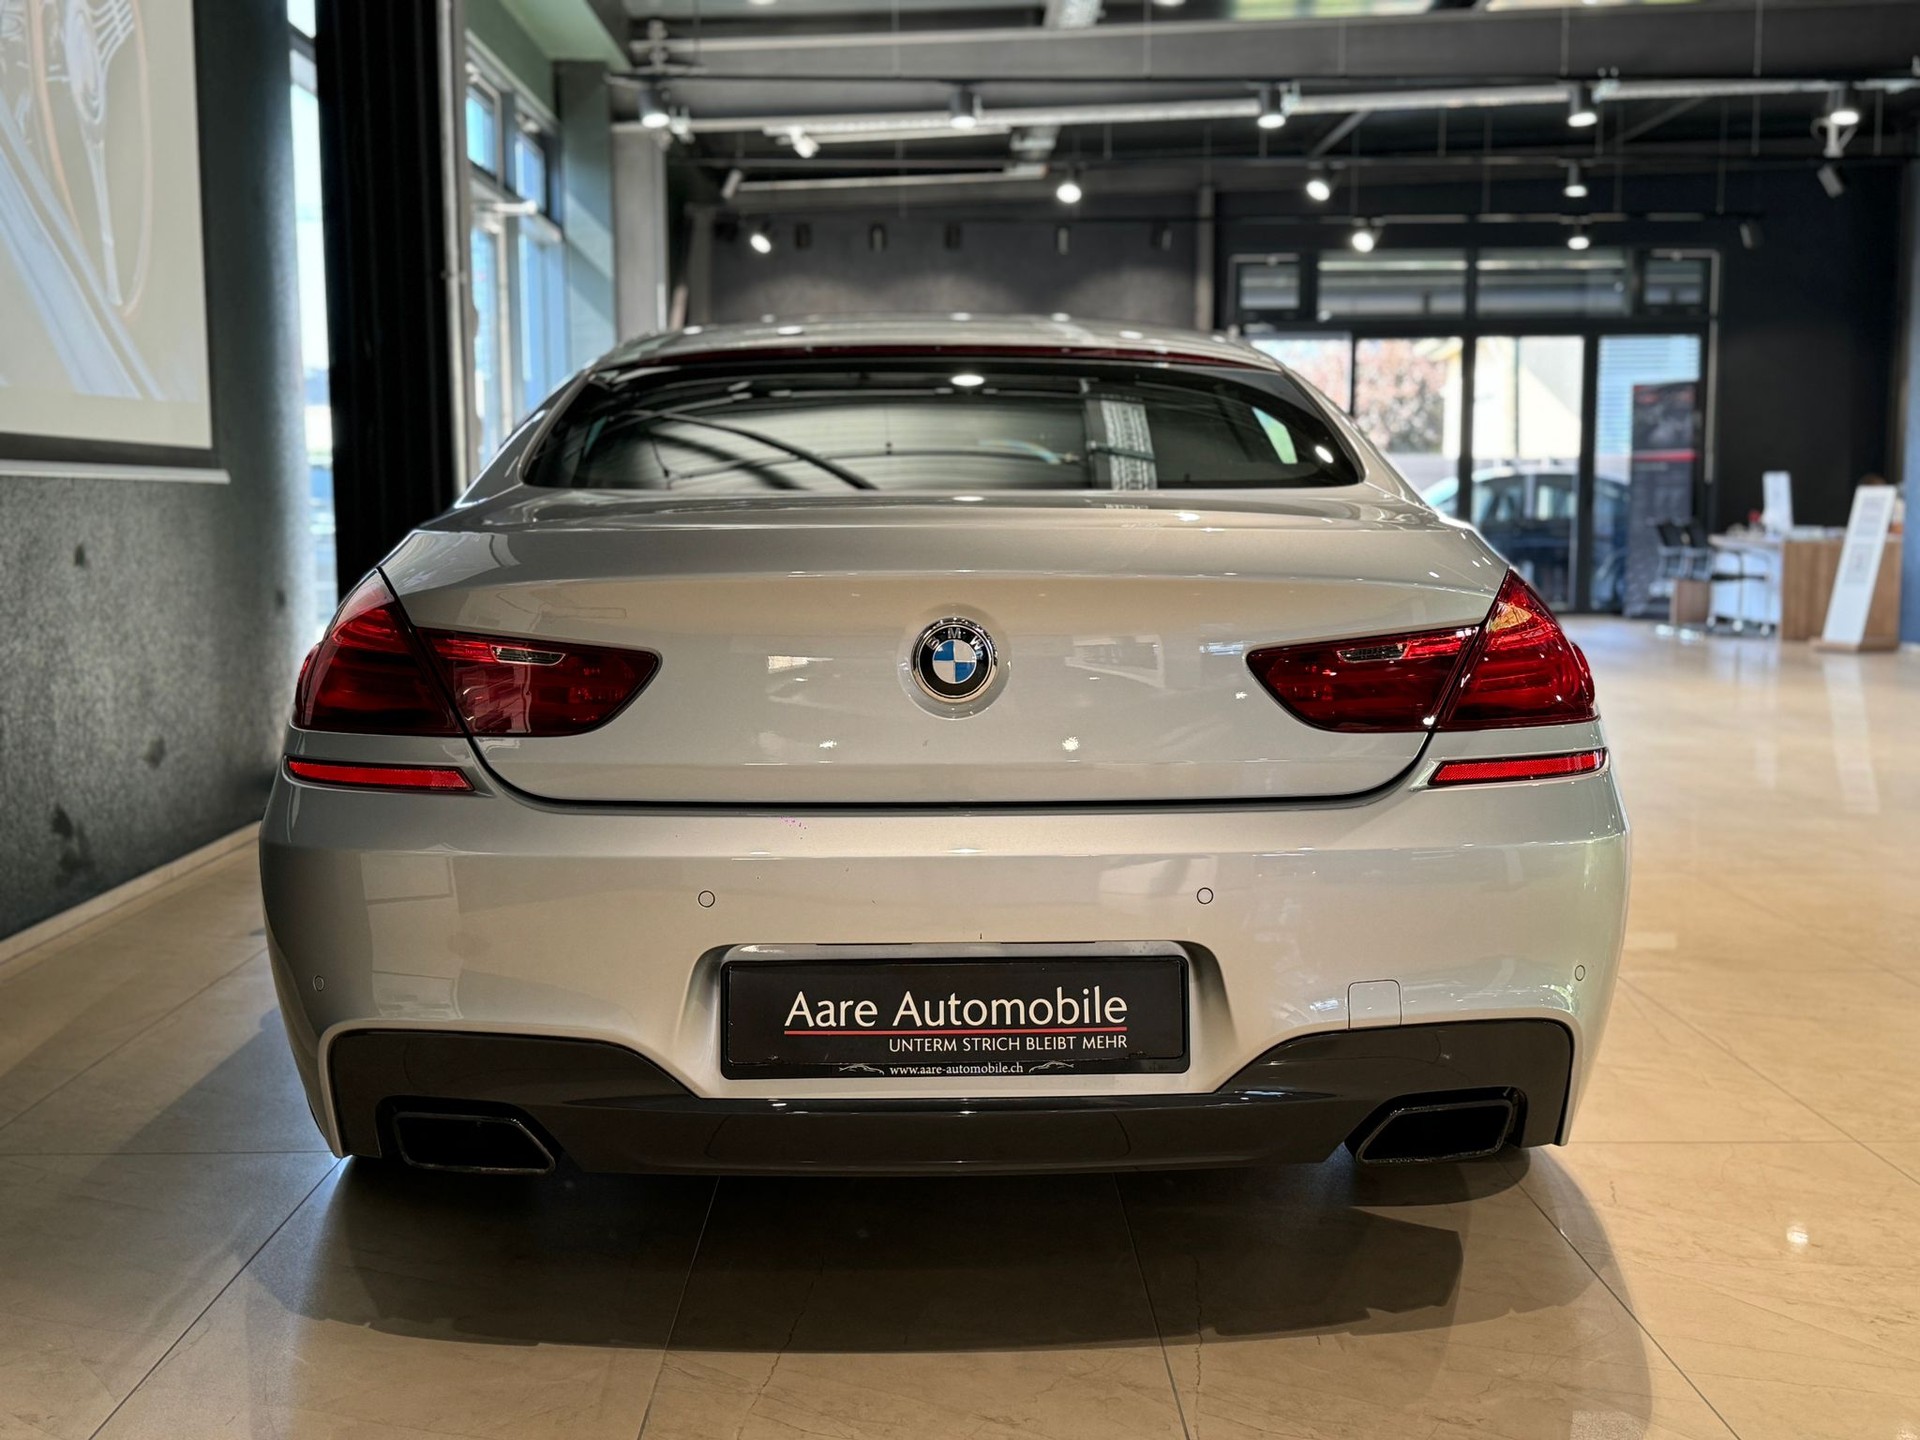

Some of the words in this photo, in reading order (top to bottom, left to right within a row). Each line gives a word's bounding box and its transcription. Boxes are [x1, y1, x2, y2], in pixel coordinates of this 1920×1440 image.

[784, 990, 879, 1028] Aare
[892, 985, 1128, 1027] Automobile
[888, 1037, 958, 1053] UNTERM
[962, 1036, 1021, 1052] STRICH
[1025, 1035, 1077, 1051] BLEIBT
[1081, 1034, 1128, 1050] MEHR
[889, 1062, 1024, 1077] www.aare-automobile.ch
